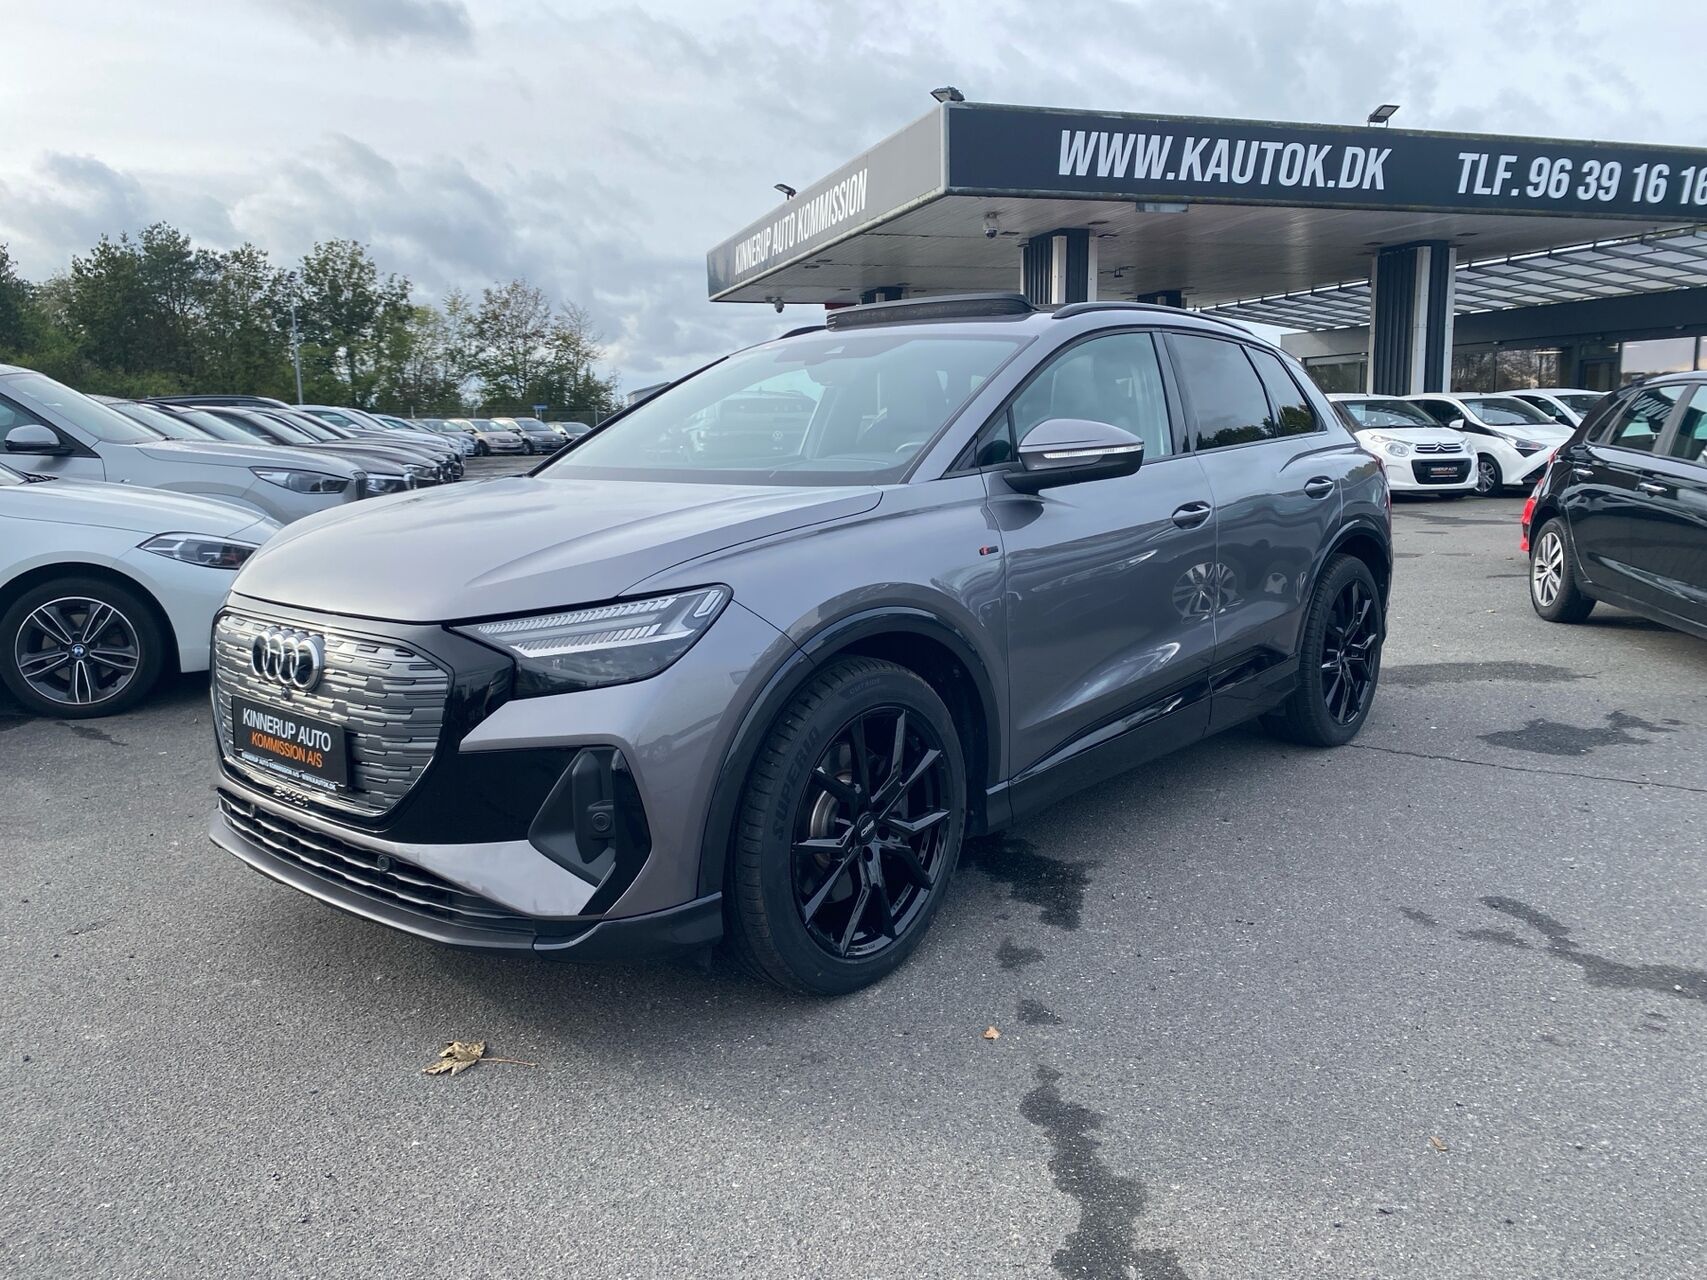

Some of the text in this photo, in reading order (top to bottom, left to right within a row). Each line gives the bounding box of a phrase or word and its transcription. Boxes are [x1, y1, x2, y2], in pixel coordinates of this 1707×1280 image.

[1059, 130, 1392, 189] WWW.KAUTOK.DK
[1457, 152, 1519, 196] TLF.
[1526, 157, 1573, 198] 96
[1577, 160, 1622, 201] 39
[1632, 163, 1670, 203] 16
[735, 168, 868, 275] KINNERUP AUTO KOMMISSION
[243, 708, 331, 751] KINNERUP AUTO
[252, 732, 305, 762] KOMMISSION
